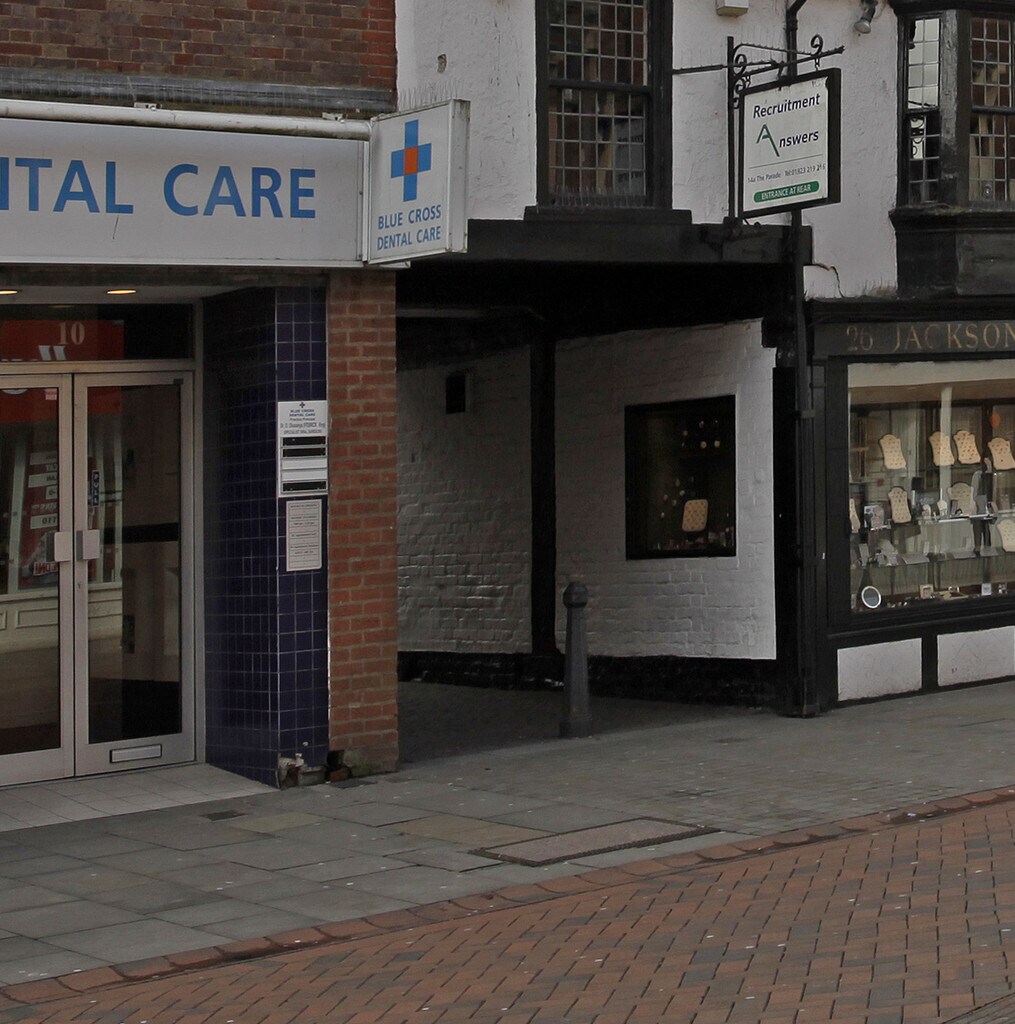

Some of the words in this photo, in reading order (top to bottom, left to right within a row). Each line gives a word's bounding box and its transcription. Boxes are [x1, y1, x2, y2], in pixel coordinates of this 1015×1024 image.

[753, 93, 821, 119] Recruitment
[756, 123, 819, 158] Answers
[0, 157, 134, 214] TAL
[163, 163, 316, 219] CARE
[765, 172, 782, 181] Parade
[761, 188, 788, 201] ENTRANCE
[788, 186, 797, 195] AT
[796, 183, 812, 194] REAR
[378, 212, 403, 230] BLUE
[408, 204, 442, 224] CROSS
[376, 231, 413, 251] DENTAL
[416, 225, 442, 243] CARE
[57, 321, 86, 345] 10
[846, 325, 874, 352] 26
